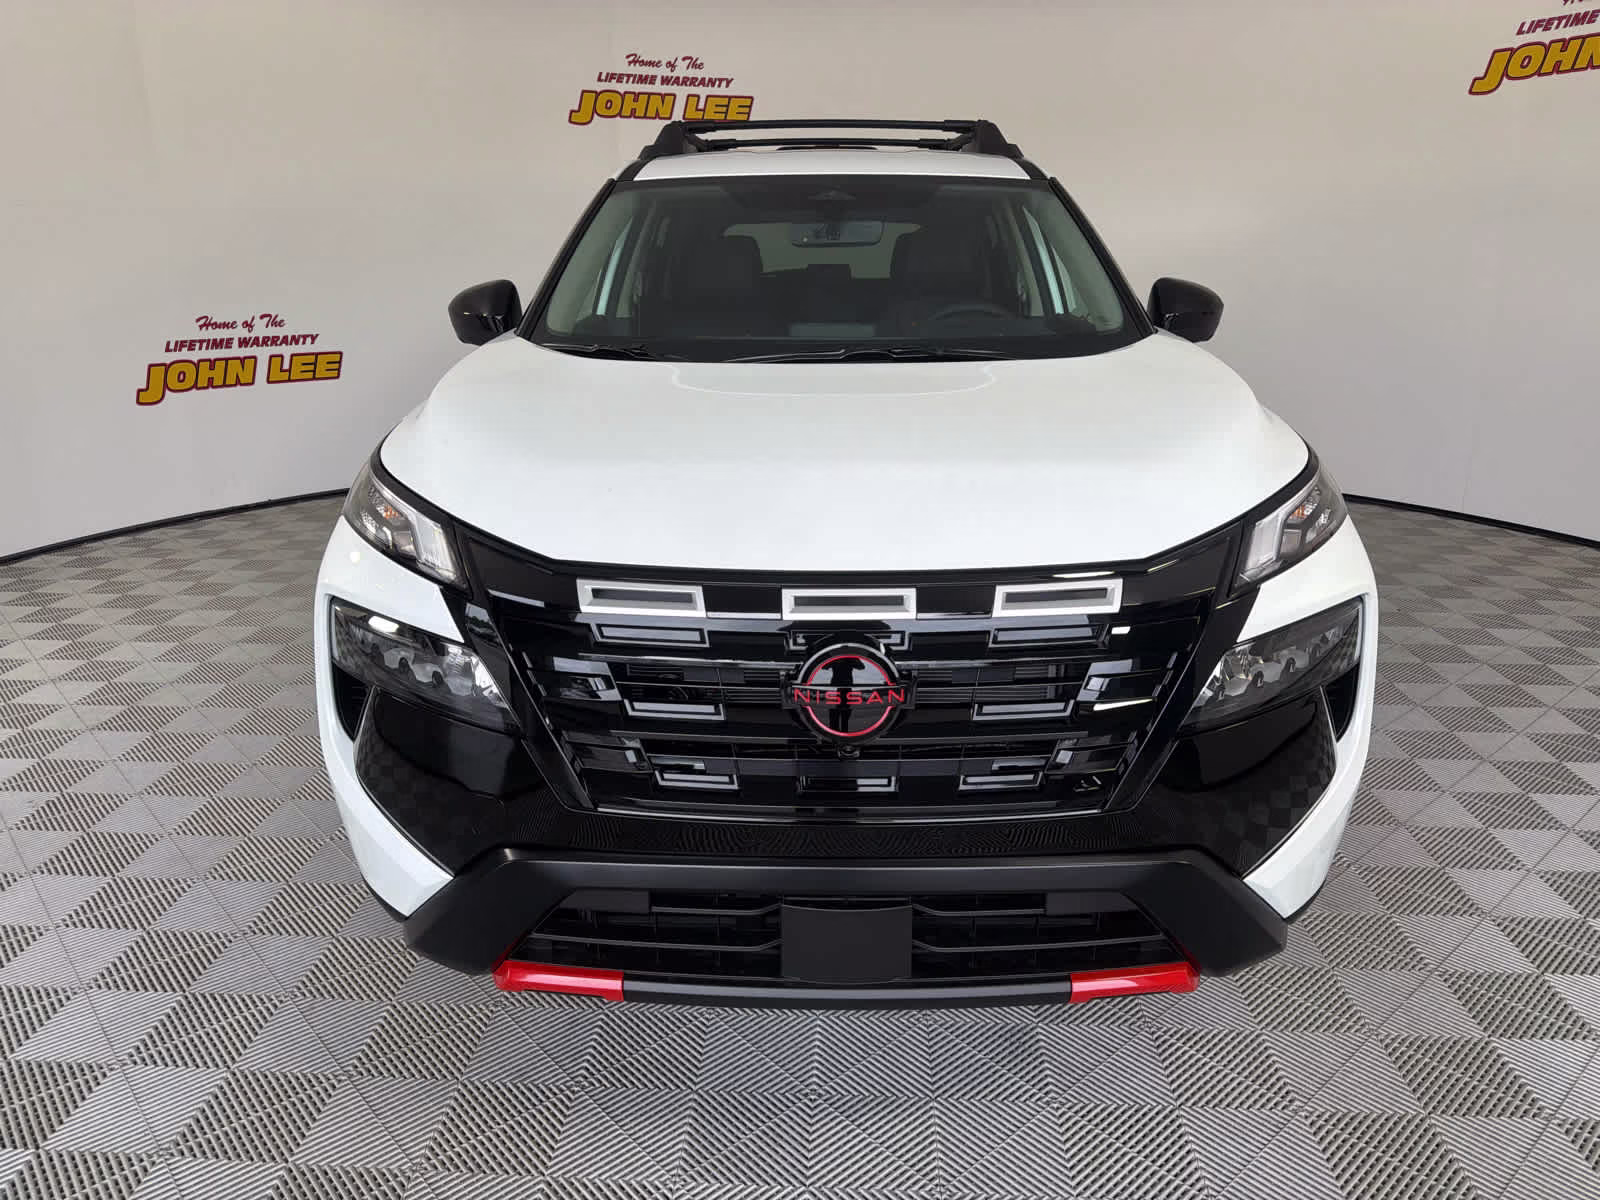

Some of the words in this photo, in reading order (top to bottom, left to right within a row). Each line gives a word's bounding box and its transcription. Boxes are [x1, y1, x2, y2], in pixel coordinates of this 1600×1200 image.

[1516, 9, 1600, 36] LIFETIME
[625, 53, 663, 69] Home
[665, 57, 679, 73] of
[681, 55, 704, 70] The
[597, 71, 656, 85] LIFETIME
[660, 75, 734, 89] WARRANTY
[568, 89, 676, 126] JOHN
[682, 94, 754, 121] LEE
[195, 315, 238, 331] Home
[241, 315, 255, 333] of
[259, 313, 286, 329] The
[165, 337, 234, 353] LIFETIME
[238, 333, 319, 349] WARRANTY
[136, 355, 257, 406] JOHN
[266, 351, 343, 384] LEE
[793, 687, 905, 706] NISSAN
